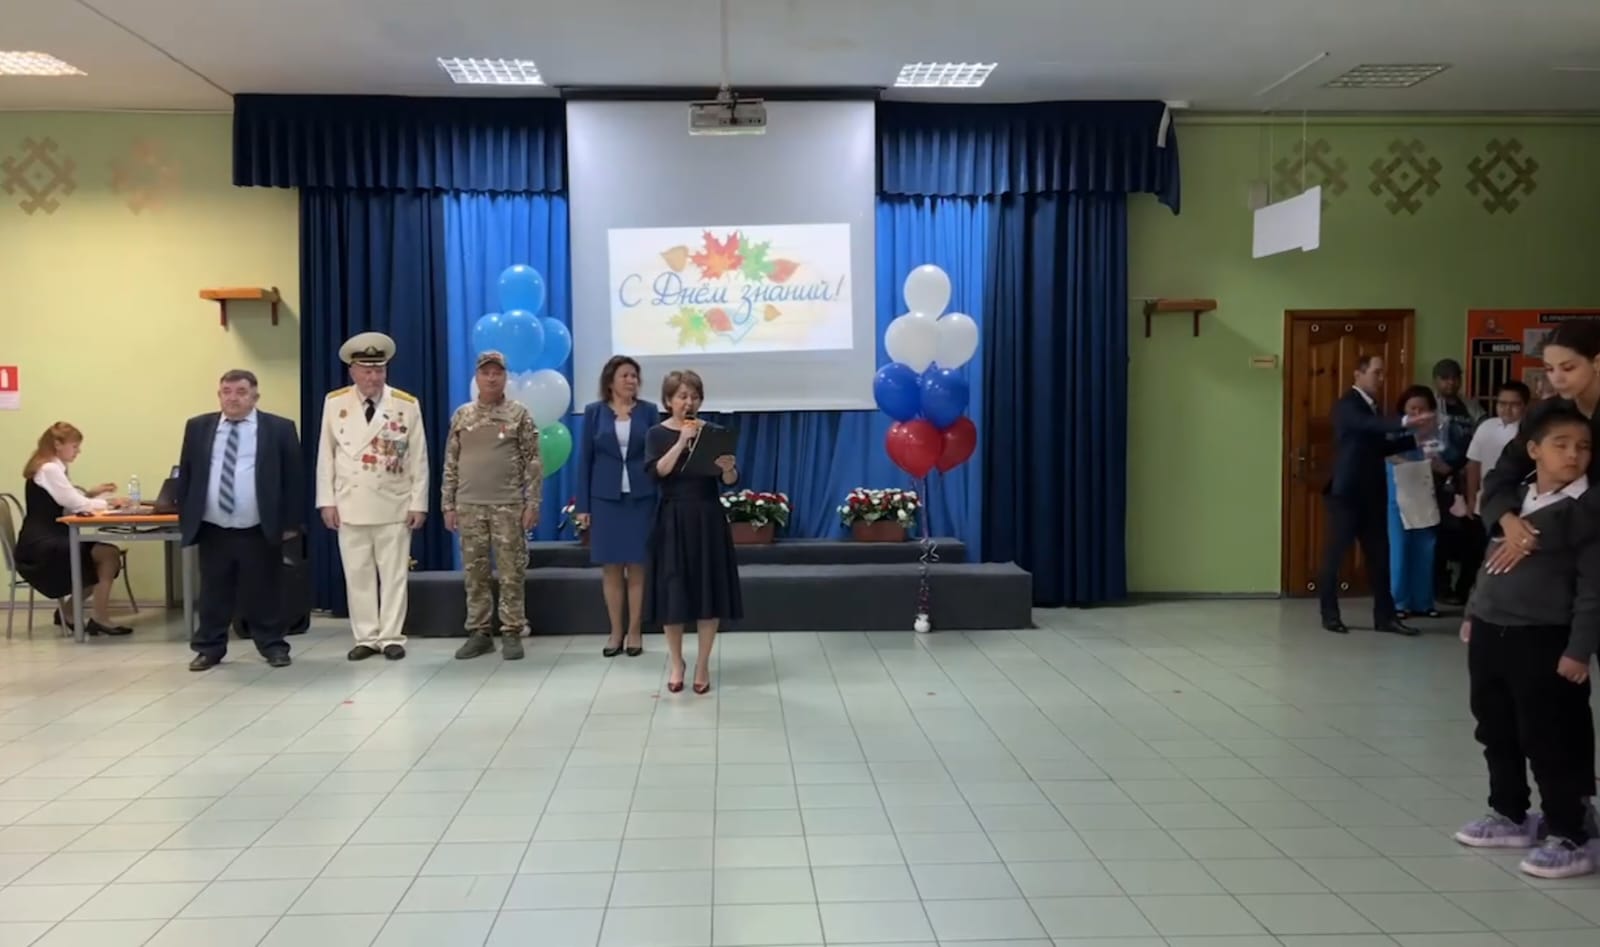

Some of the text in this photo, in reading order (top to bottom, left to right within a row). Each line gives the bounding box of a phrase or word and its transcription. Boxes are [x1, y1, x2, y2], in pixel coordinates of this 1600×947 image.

[619, 271, 845, 325] С Днём знаний!
